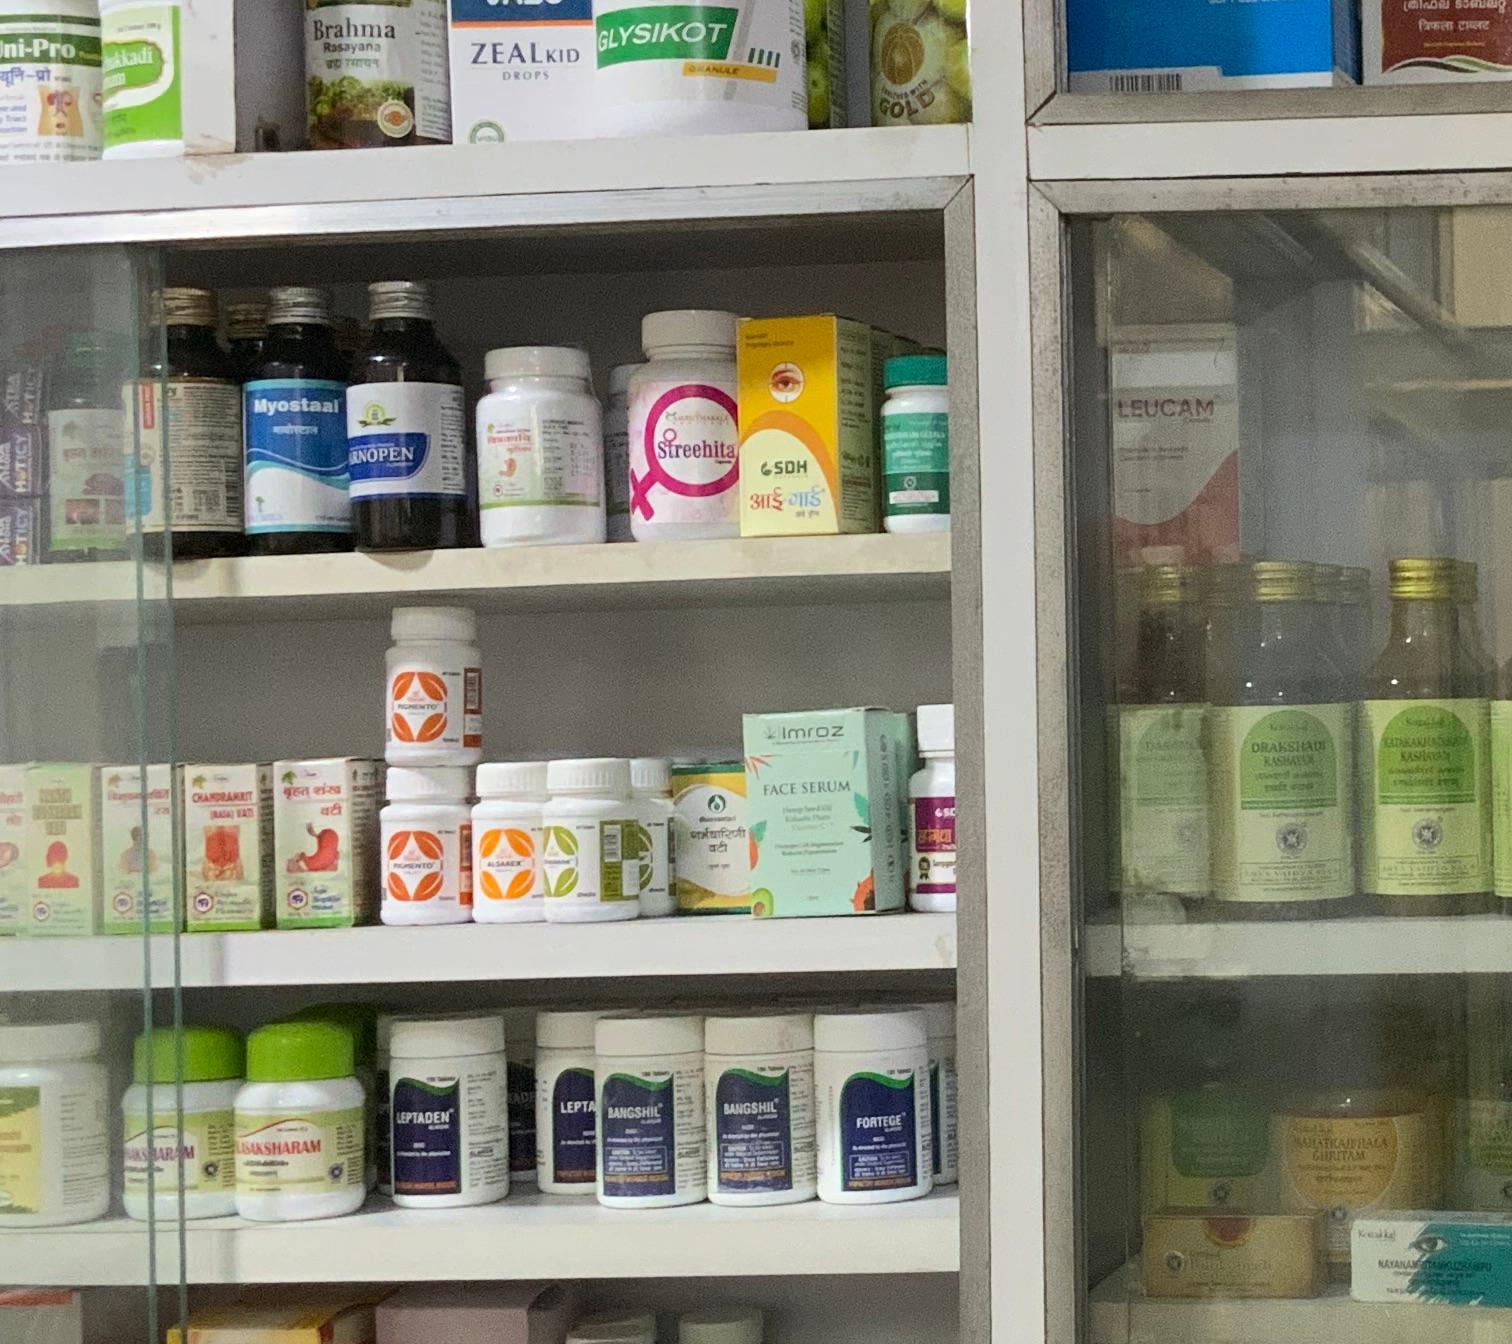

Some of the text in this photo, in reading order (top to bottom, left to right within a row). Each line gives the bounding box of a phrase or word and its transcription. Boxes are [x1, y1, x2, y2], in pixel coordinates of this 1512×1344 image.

[312, 16, 396, 40] Brahma
[597, 22, 728, 53] GLYSIKOT
[322, 41, 382, 56] Rasayana
[471, 42, 581, 65] ZEAL KID
[502, 69, 550, 81] DROPS
[879, 88, 936, 119] GOLD
[253, 396, 340, 417] Myostaal
[1117, 398, 1215, 418] LEUCAM
[657, 438, 736, 460] Streehita
[775, 459, 808, 476] SDH
[763, 779, 852, 798] FACE SERUM
[319, 803, 343, 818] वटी
[392, 861, 434, 871] PIGMENTO
[607, 1104, 662, 1120] BANGSHIL
[723, 1101, 778, 1116] BANGSHIL
[396, 1110, 450, 1126] LEPTADEN
[856, 1114, 902, 1129] FORTEGE
